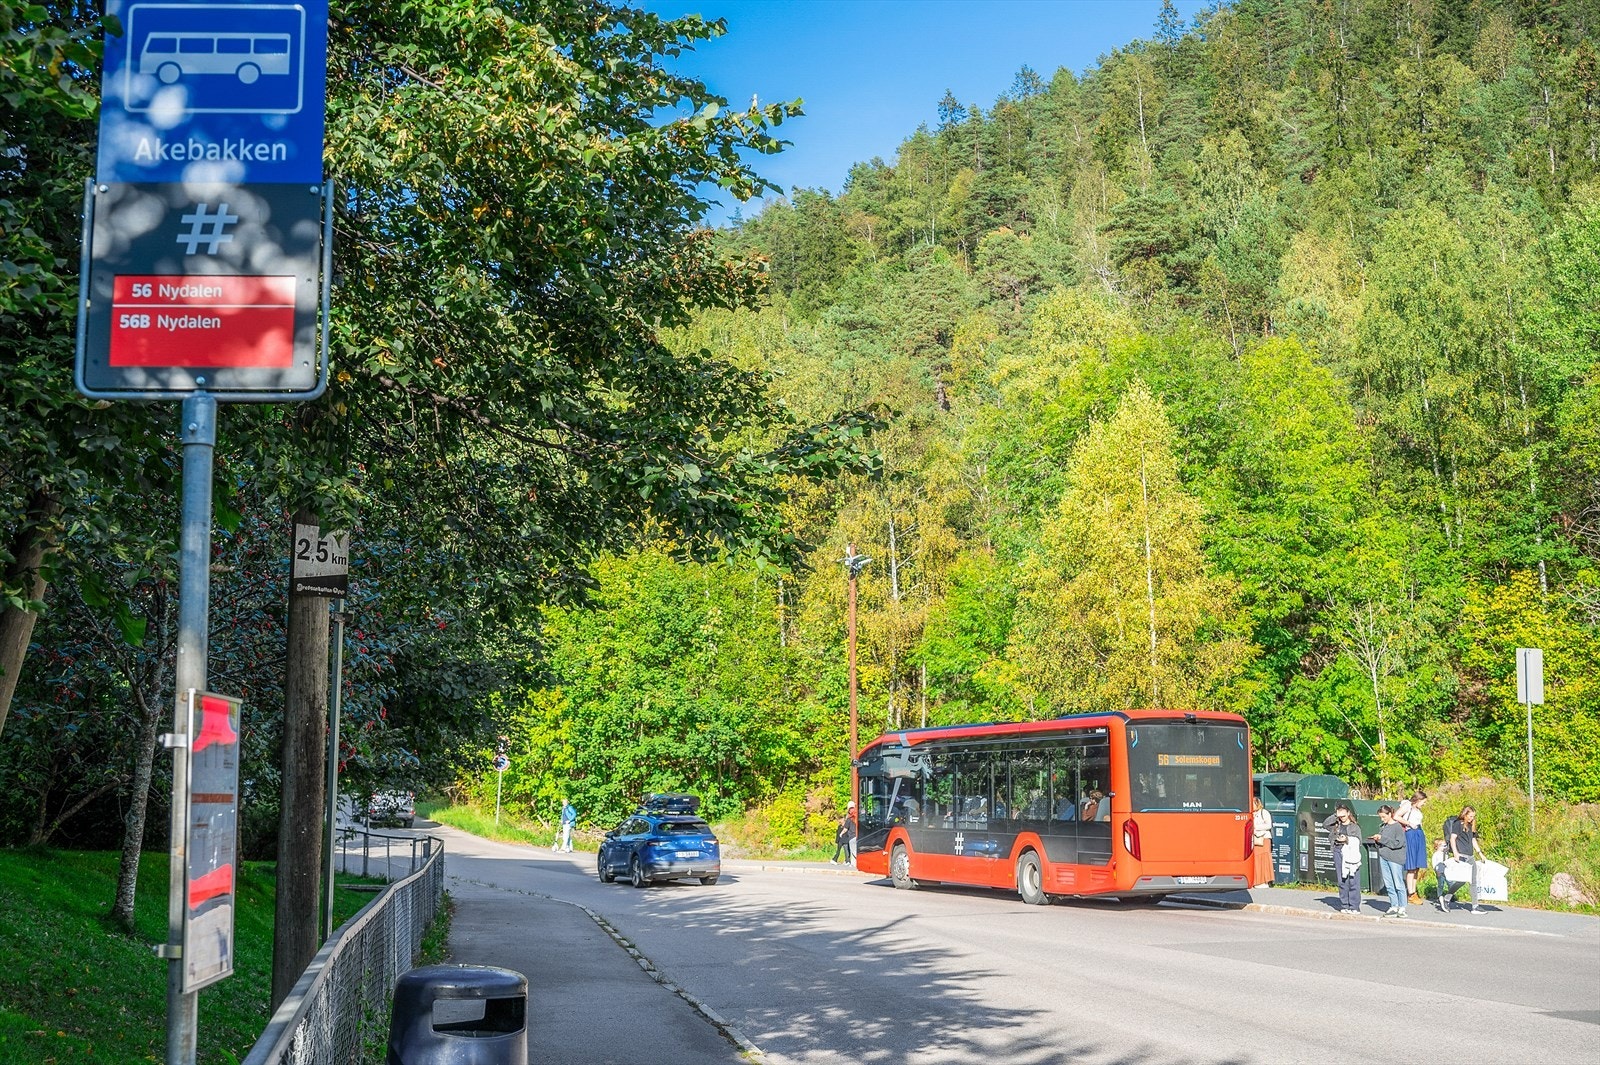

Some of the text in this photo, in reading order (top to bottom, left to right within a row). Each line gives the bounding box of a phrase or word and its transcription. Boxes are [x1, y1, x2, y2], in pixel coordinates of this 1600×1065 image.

[134, 137, 287, 161] Akebakken
[131, 283, 222, 301] 56 Nydalen
[119, 314, 221, 332] 56B Nydalen
[297, 538, 347, 565] 2,5 km
[1158, 754, 1220, 766] 56 Solemskogen
